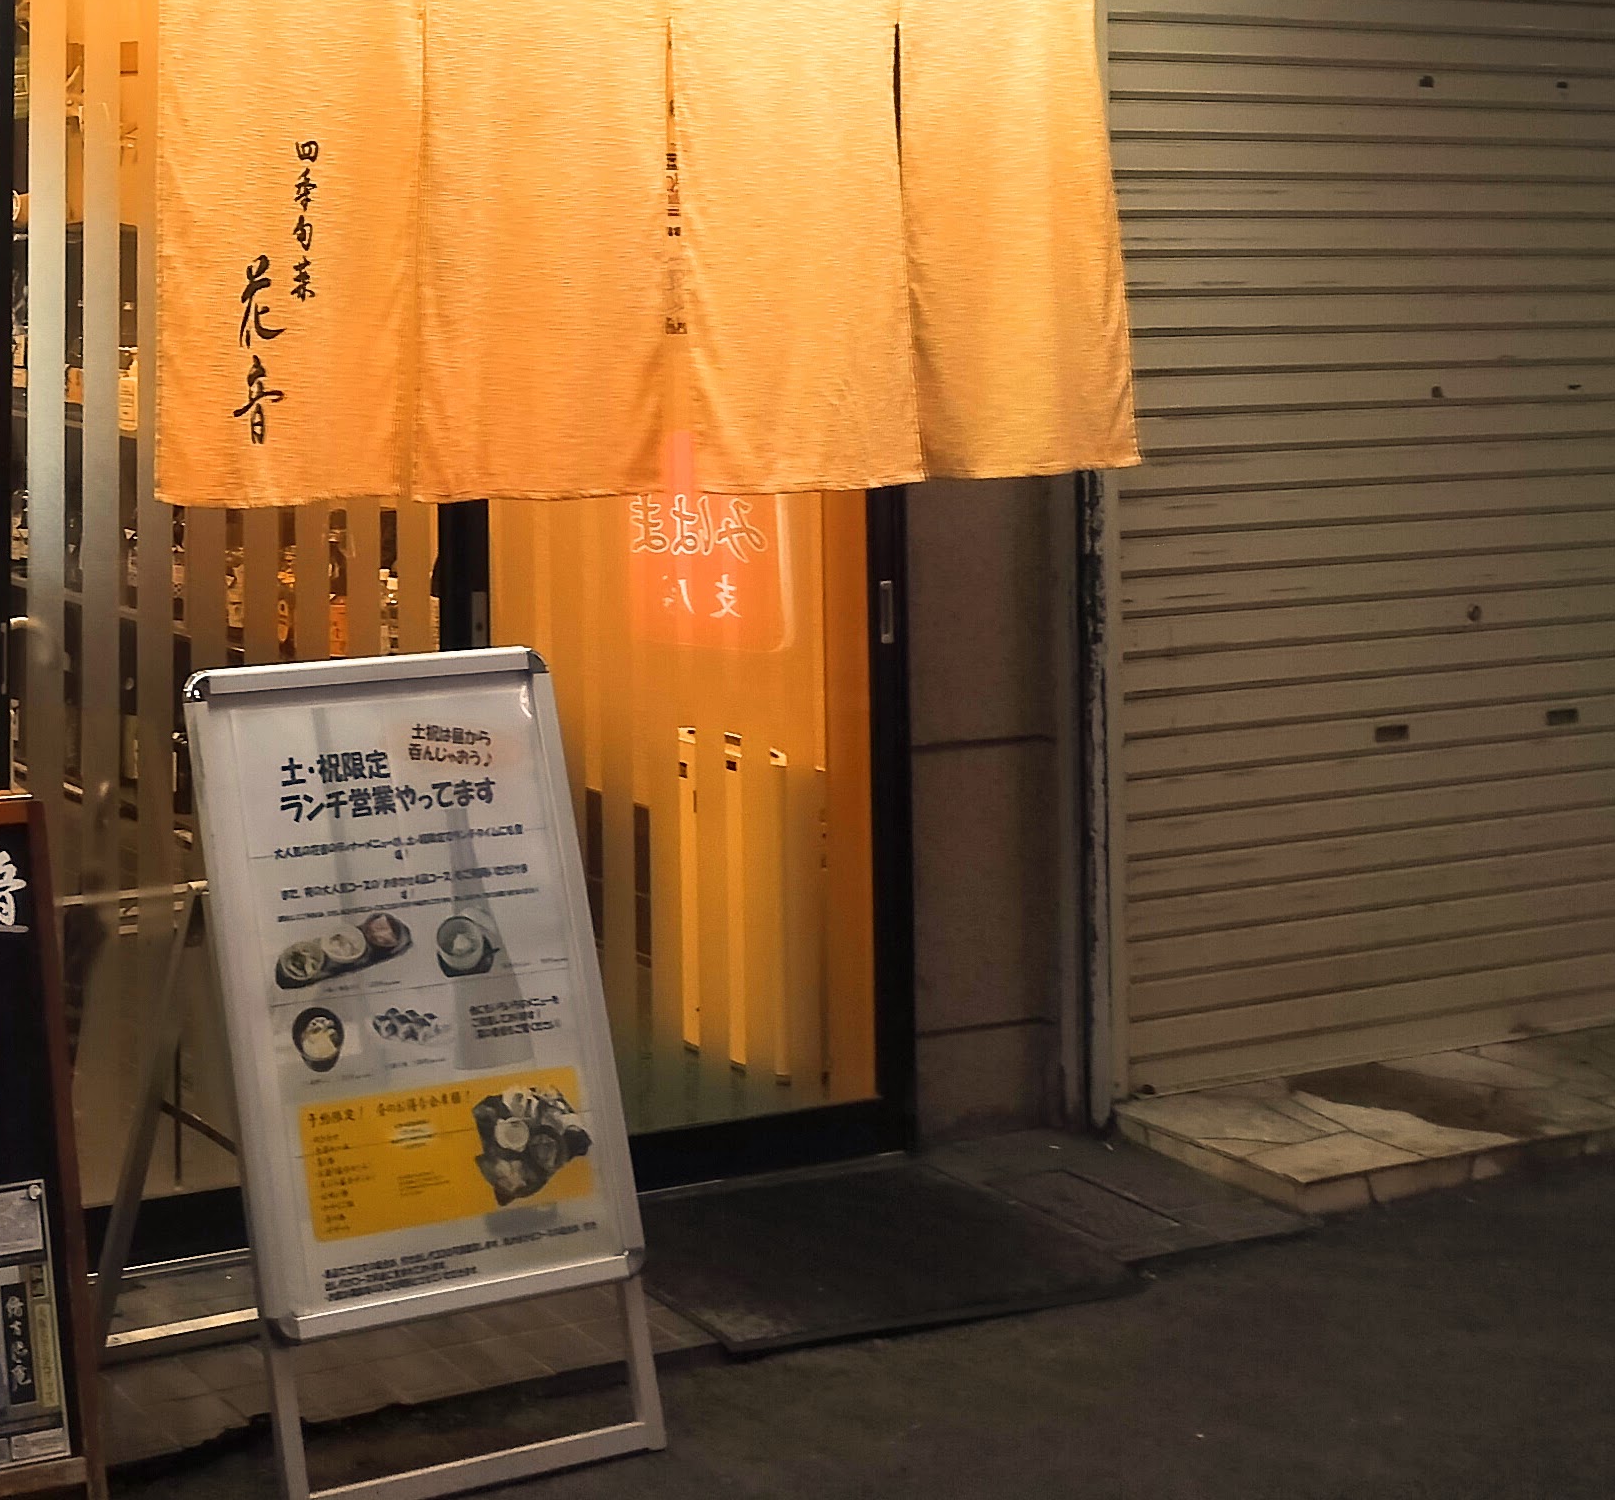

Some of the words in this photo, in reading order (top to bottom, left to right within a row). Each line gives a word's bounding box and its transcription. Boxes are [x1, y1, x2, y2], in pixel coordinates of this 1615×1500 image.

[290, 139, 319, 302] 四季旬菜
[233, 254, 287, 445] 花音
[280, 777, 496, 822] ランチ営業やってます
